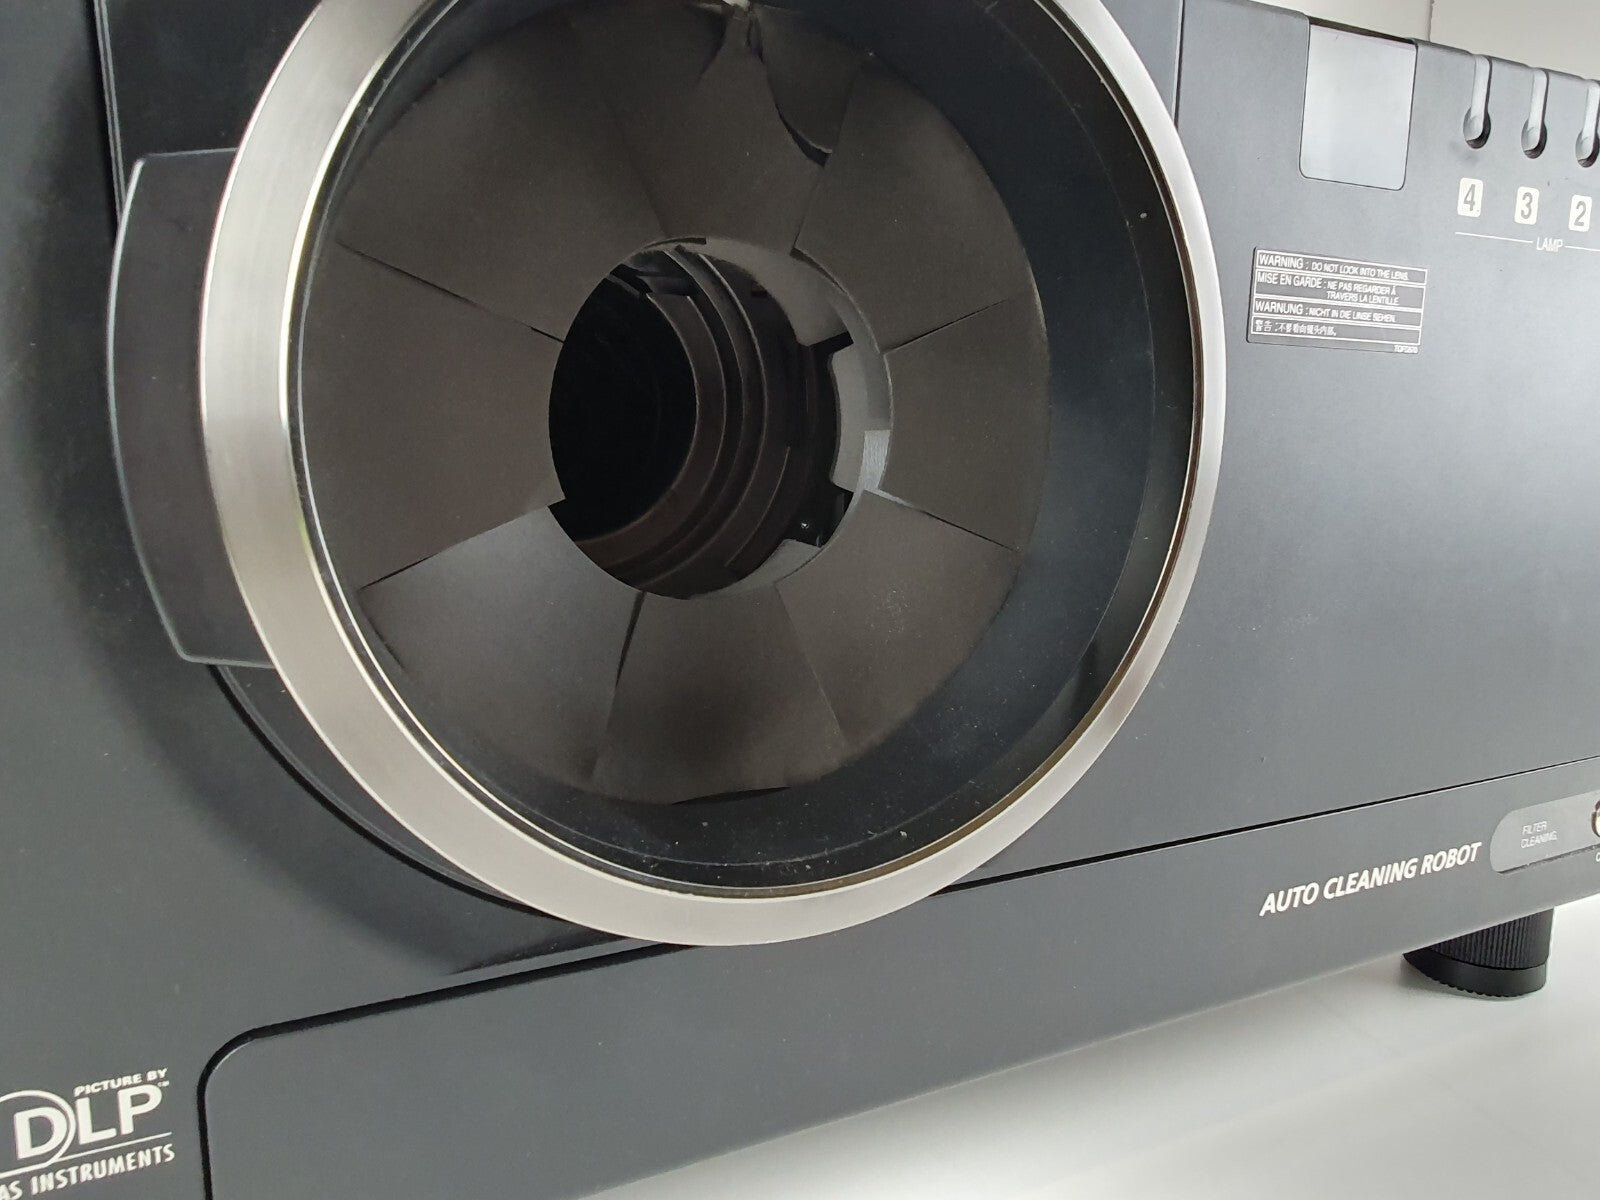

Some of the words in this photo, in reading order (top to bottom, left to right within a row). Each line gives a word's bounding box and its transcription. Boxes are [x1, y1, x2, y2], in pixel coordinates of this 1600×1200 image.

[1463, 183, 1476, 212] 4
[1520, 191, 1533, 220] 3
[1573, 200, 1587, 227] 2
[1536, 236, 1564, 253] LAMP
[1258, 253, 1304, 269] WARNING
[1311, 262, 1322, 271] DO
[1323, 263, 1339, 273] NOT
[1339, 264, 1359, 275] LOOK
[1359, 267, 1376, 277] INTO
[1376, 268, 1391, 279] THE
[1257, 271, 1279, 285] MISE
[1279, 274, 1292, 286] EN
[1293, 275, 1322, 288] GARDE
[1327, 280, 1337, 290] NE
[1338, 281, 1353, 292] PAS
[1353, 283, 1391, 295] REGARDER
[1326, 290, 1359, 302] TRAVERS
[1359, 293, 1368, 303] LA
[1255, 300, 1304, 315] WARNUNG
[1308, 307, 1331, 317] NICHT
[1331, 309, 1339, 318] IN
[1339, 309, 1352, 320] DIE
[1352, 310, 1372, 321] LINSE
[1520, 830, 1558, 849] CLEANING
[1522, 820, 1548, 835] FILTER
[1258, 882, 1320, 917] AUTO
[1323, 856, 1418, 900] CLEANING
[1420, 841, 1482, 876] ROBOT
[73, 1073, 142, 1098] PICTURE
[146, 1067, 168, 1082] BY
[13, 1084, 163, 1161] DLP
[30, 1143, 175, 1196] INSTRUMENTS
